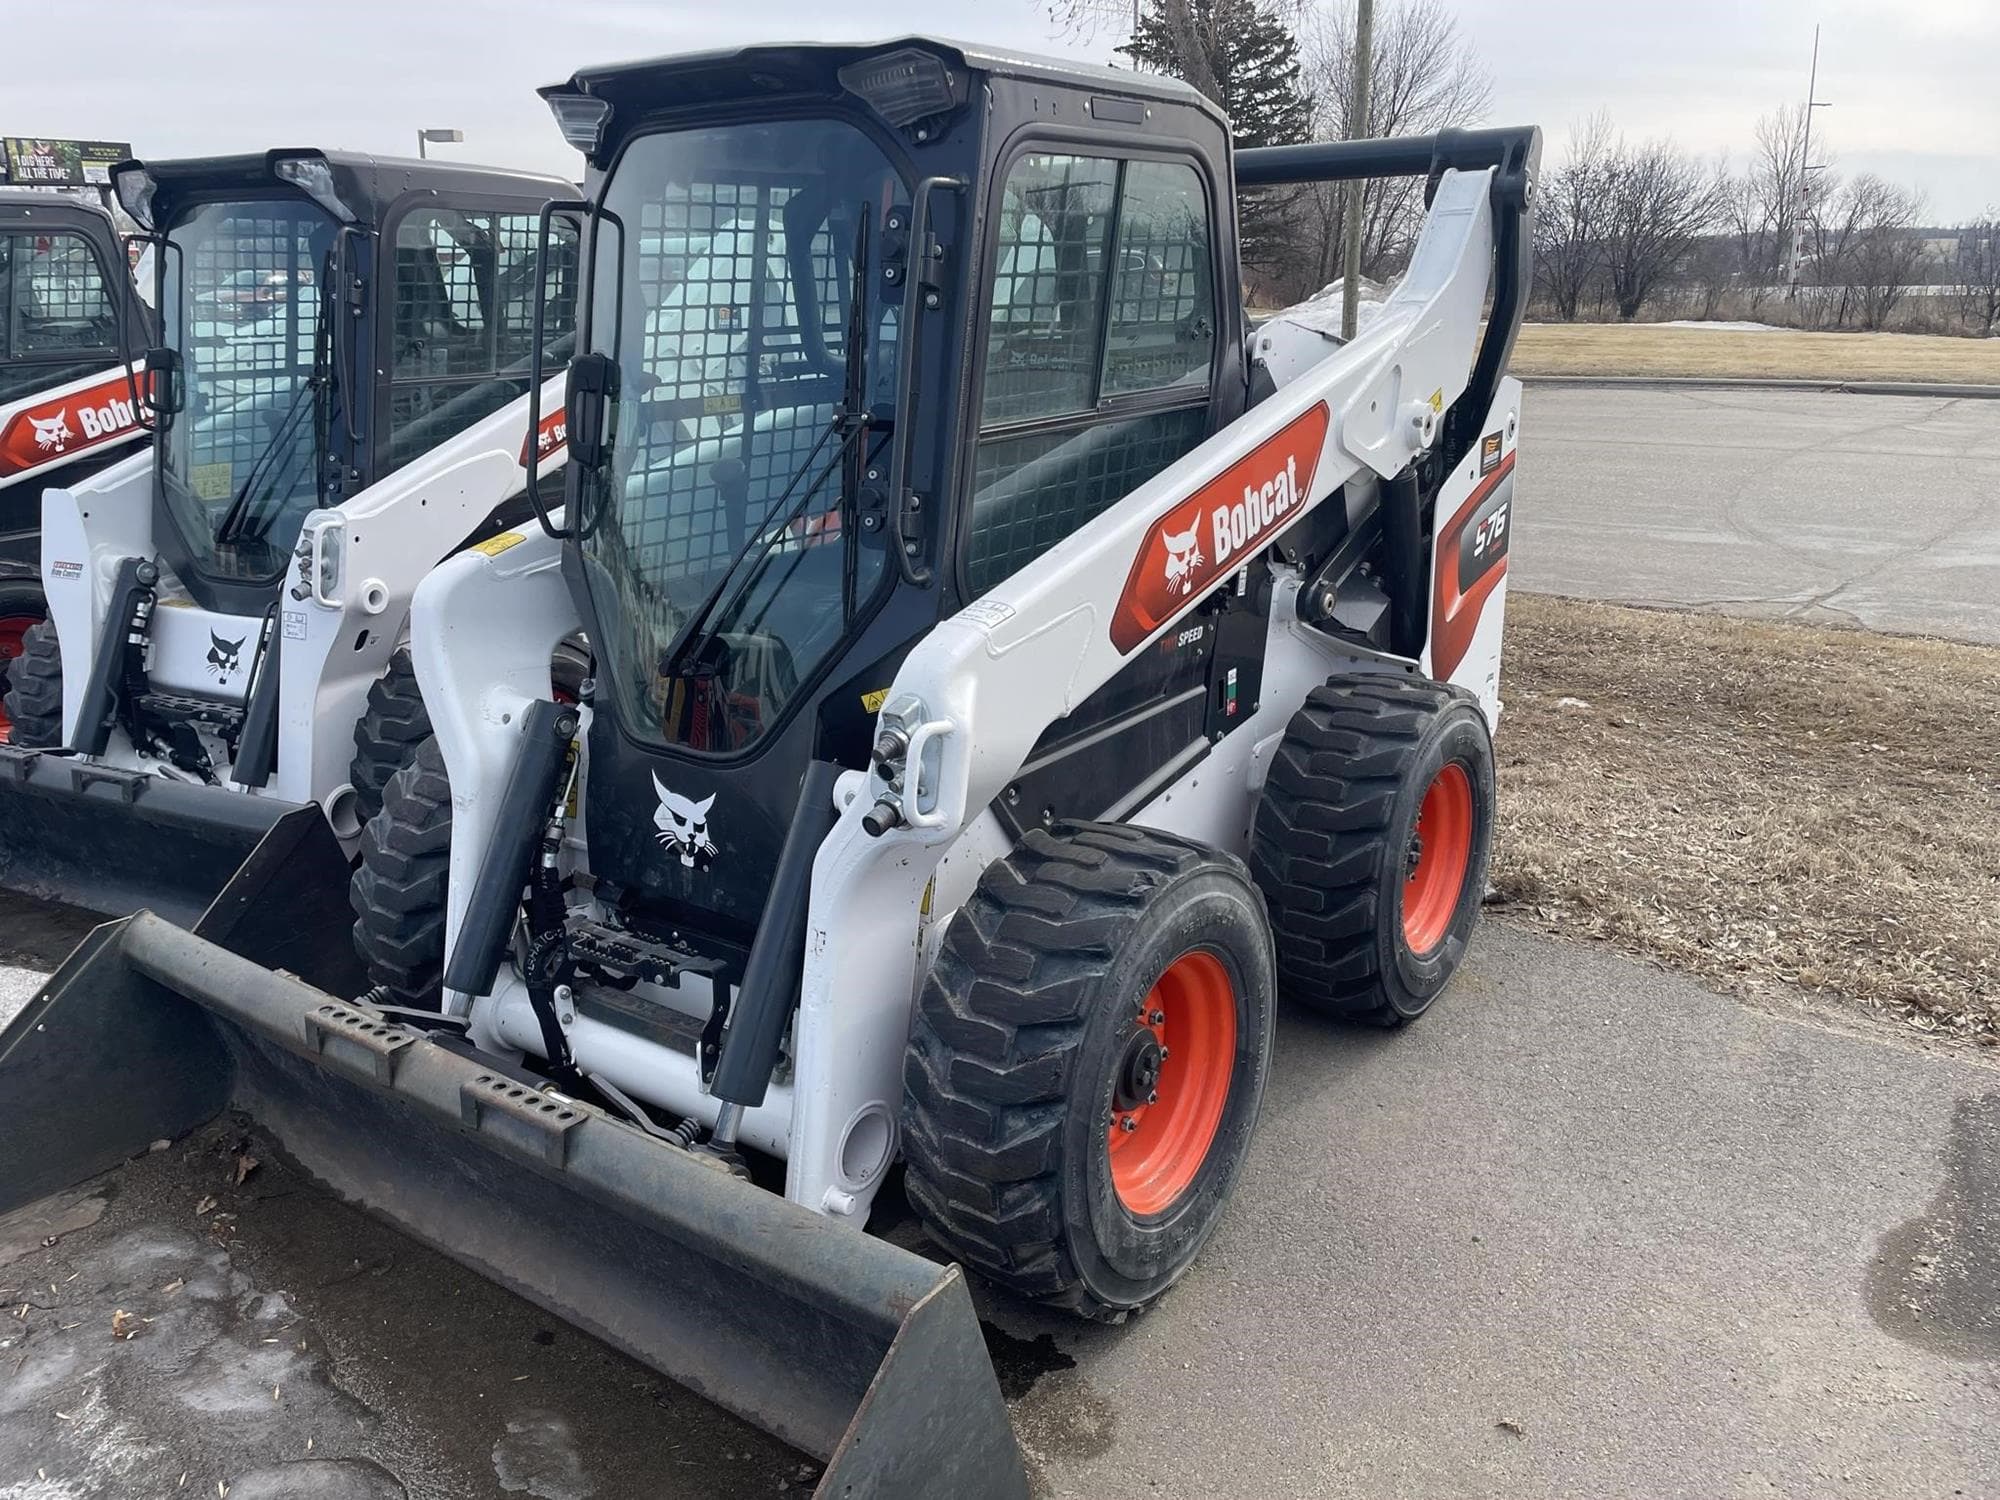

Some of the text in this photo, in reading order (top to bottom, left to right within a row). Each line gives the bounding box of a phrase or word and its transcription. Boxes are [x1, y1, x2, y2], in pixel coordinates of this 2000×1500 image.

[21, 155, 35, 166] DIG
[35, 155, 56, 167] HERE
[19, 167, 33, 178] ALL
[34, 168, 49, 179] THE
[1212, 454, 1297, 566] Bobcat
[1473, 502, 1508, 558] S76
[1178, 626, 1204, 647] SPEED
